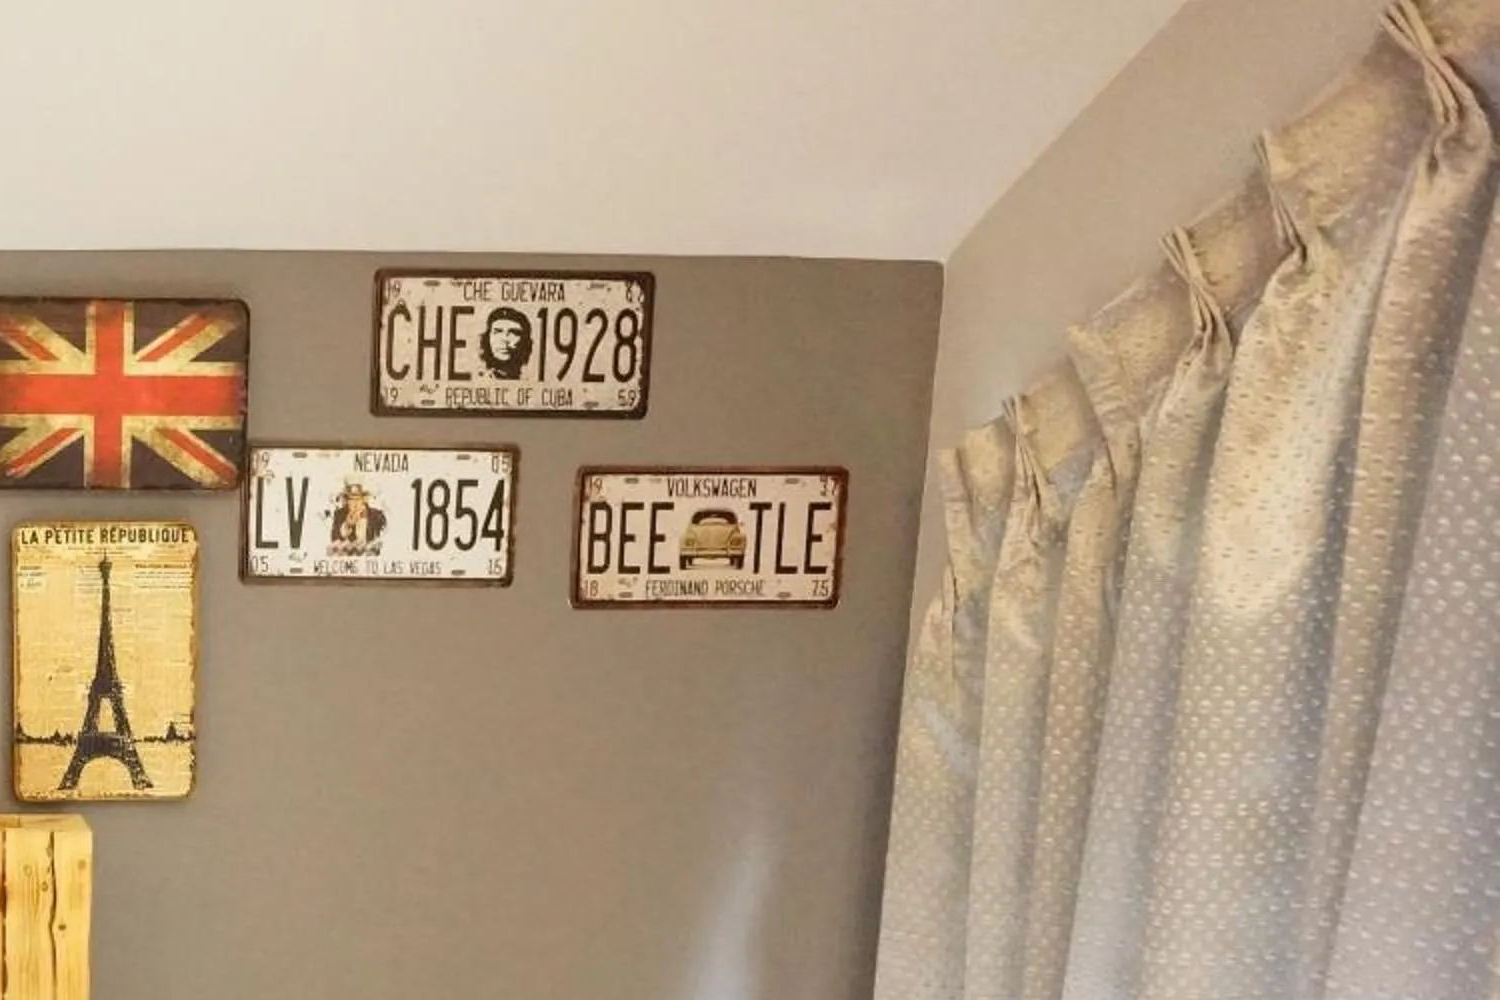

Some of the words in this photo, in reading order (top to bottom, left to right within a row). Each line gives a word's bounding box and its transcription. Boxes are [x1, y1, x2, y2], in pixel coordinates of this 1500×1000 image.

[463, 282, 491, 302] CHE
[501, 283, 566, 303] GUEVARA
[385, 303, 475, 381] CHE
[536, 307, 639, 383] 1928
[445, 387, 509, 407] REPUBLIC
[517, 387, 533, 406] OF
[541, 387, 573, 407] CUBA
[617, 389, 638, 407] 59
[354, 453, 410, 473] NEVADA
[667, 477, 757, 498] VOLKSWAGEN
[410, 478, 506, 551] 1854
[21, 530, 39, 545] LA
[45, 528, 95, 545] PETITE
[100, 526, 189, 545] RÉPUBLIQUE
[587, 502, 675, 574] BEE
[749, 502, 832, 574] TLE
[313, 559, 359, 575] WELCOME
[365, 560, 380, 575] TO
[384, 560, 404, 575] LAS
[409, 560, 442, 576] VEGAS
[645, 579, 709, 597] FERDINAND
[715, 580, 765, 597] PORSCHE
